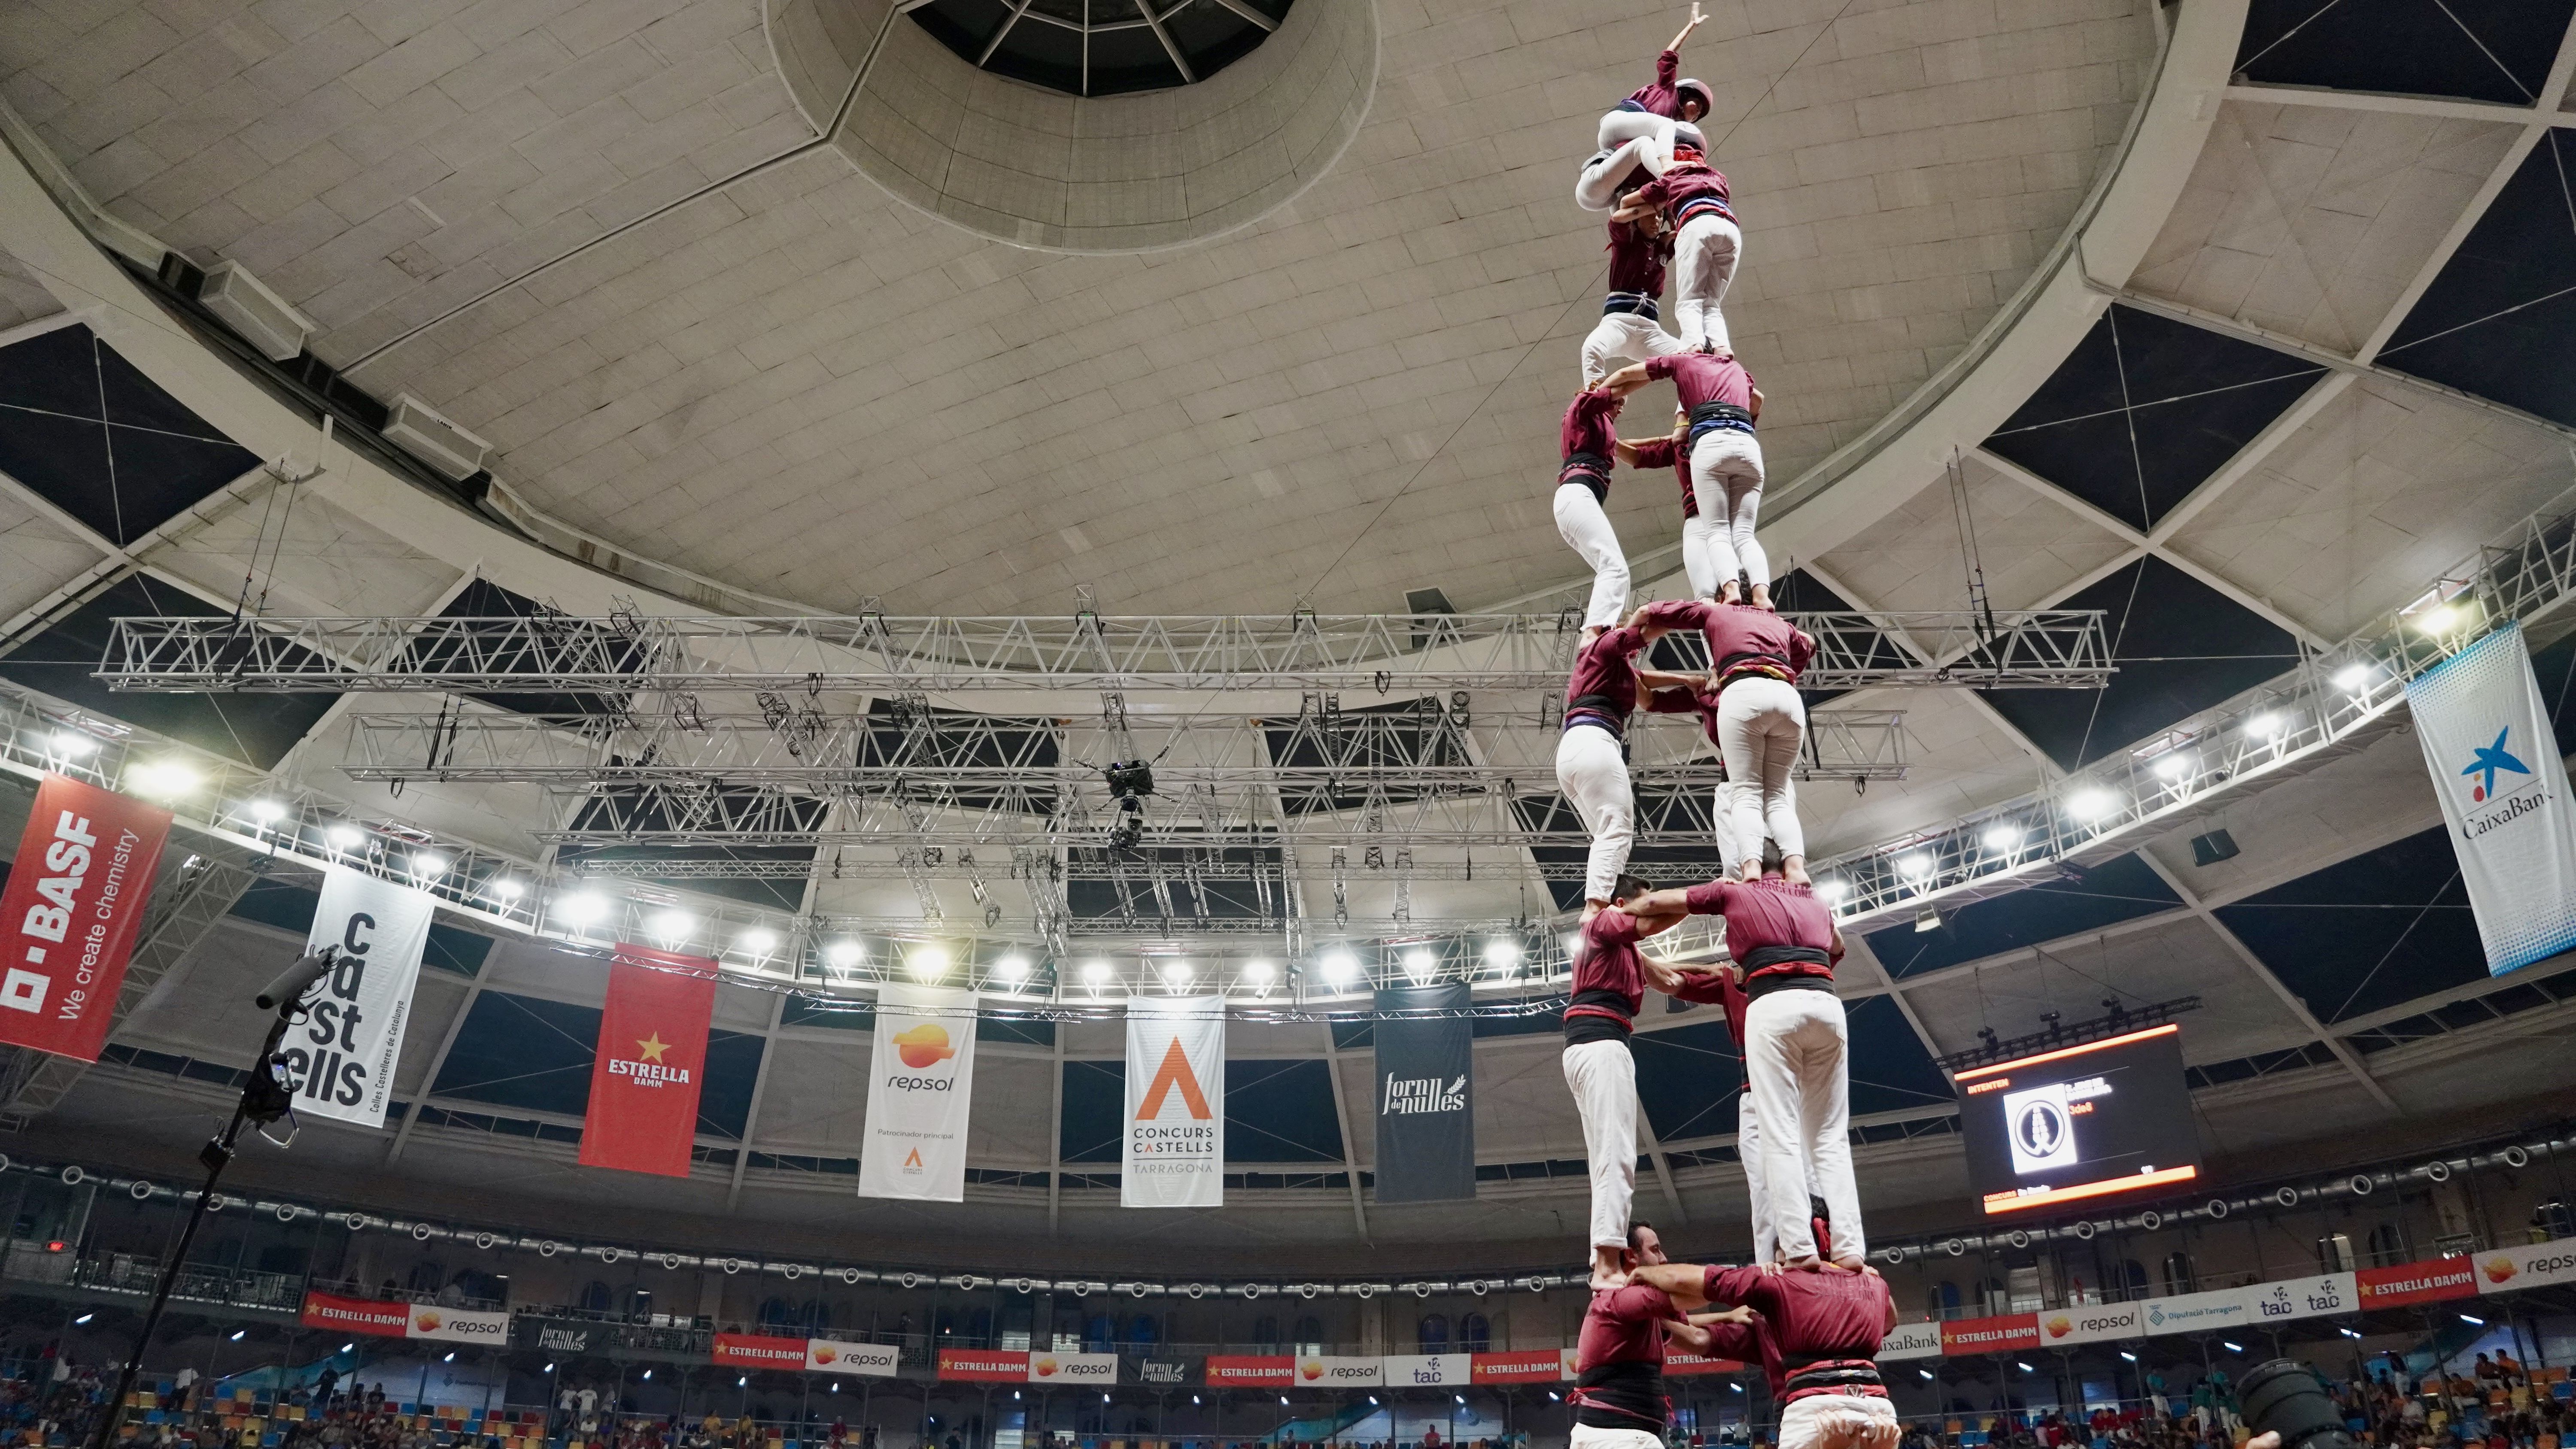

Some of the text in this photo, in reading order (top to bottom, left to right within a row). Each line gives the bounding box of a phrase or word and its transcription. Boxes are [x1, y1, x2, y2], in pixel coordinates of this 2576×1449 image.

[2463, 784, 2555, 840] CaixaBank
[21, 809, 97, 943] BASF
[58, 828, 140, 1020] We create chemistry
[370, 1000, 405, 1113] Colles Castelleres de Catalunya
[608, 1058, 689, 1083] ESTRELLA
[634, 1077, 662, 1088] DAMM
[887, 1076, 954, 1091] repsol
[1967, 1078, 2009, 1094] INTENTEN
[1391, 1099, 1400, 1109] de
[878, 1128, 922, 1137] Patrocinador
[1134, 1127, 1213, 1139] CONCURS
[1133, 1142, 1213, 1153] CASTELLS
[1133, 1164, 1213, 1174] TARRAGONA
[1983, 1190, 2017, 1202] CONCURS
[2527, 1254, 2576, 1274] reps
[2375, 1271, 2472, 1295] ESTRELLA DAMM
[2260, 1301, 2292, 1316] tac
[2307, 1294, 2339, 1310] tac
[322, 1307, 406, 1326] ESTRELLA DAMM
[2204, 1305, 2242, 1315] Tarragona
[448, 1320, 503, 1334] repsol
[2080, 1312, 2134, 1332] repsol
[1880, 1332, 1938, 1351] ixaBank
[1956, 1326, 2037, 1344] ESTRELLA DAMM
[729, 1346, 804, 1360] ESTRELLA DAMM
[843, 1352, 893, 1366] repsol
[954, 1361, 1026, 1372] ESTRELLA DAMM
[1065, 1362, 1112, 1376] repsol
[1221, 1368, 1293, 1377] ESTRELLA DAMM
[1331, 1365, 1377, 1379] repsol
[1487, 1362, 1558, 1373] ESTRELLA DAMM
[1413, 1368, 1441, 1383] tac
